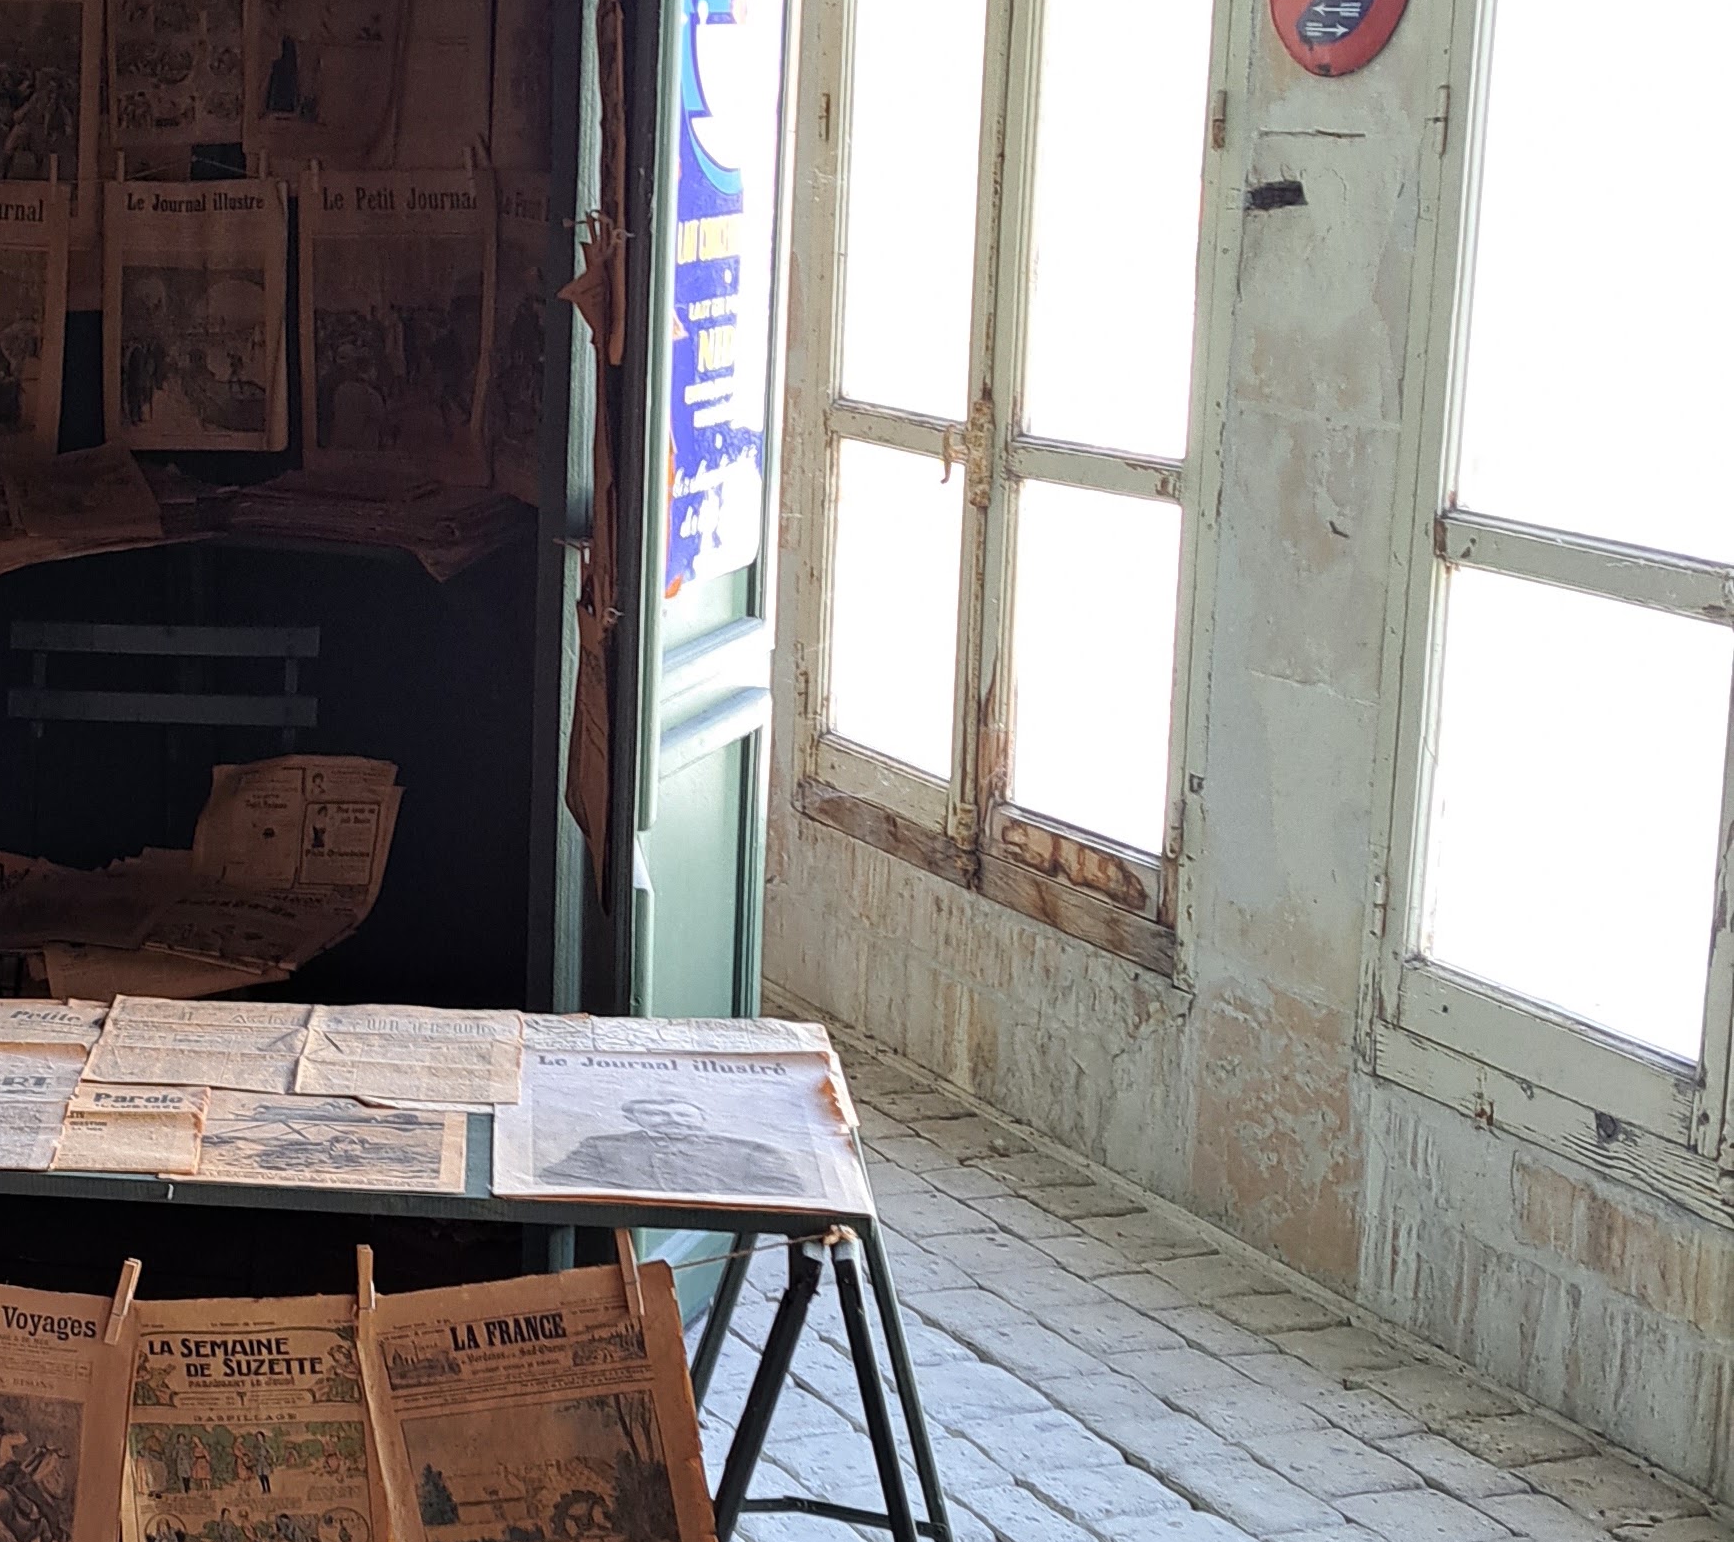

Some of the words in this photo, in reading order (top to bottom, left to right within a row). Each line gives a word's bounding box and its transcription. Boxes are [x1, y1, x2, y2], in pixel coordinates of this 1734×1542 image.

[127, 193, 145, 211] Le
[152, 192, 206, 213] Journal
[323, 187, 344, 211] Le
[355, 187, 395, 211] Petit
[537, 1054, 567, 1068] Le
[581, 1056, 679, 1073] Journal
[93, 1092, 183, 1104] Parole
[1, 1305, 97, 1340] Voyages
[449, 1326, 479, 1351] LA
[484, 1312, 566, 1347] FRANCE
[148, 1340, 175, 1356] LA
[180, 1337, 289, 1358] SEMAINE
[186, 1362, 212, 1378] DE
[223, 1357, 325, 1377] SUZETTE
